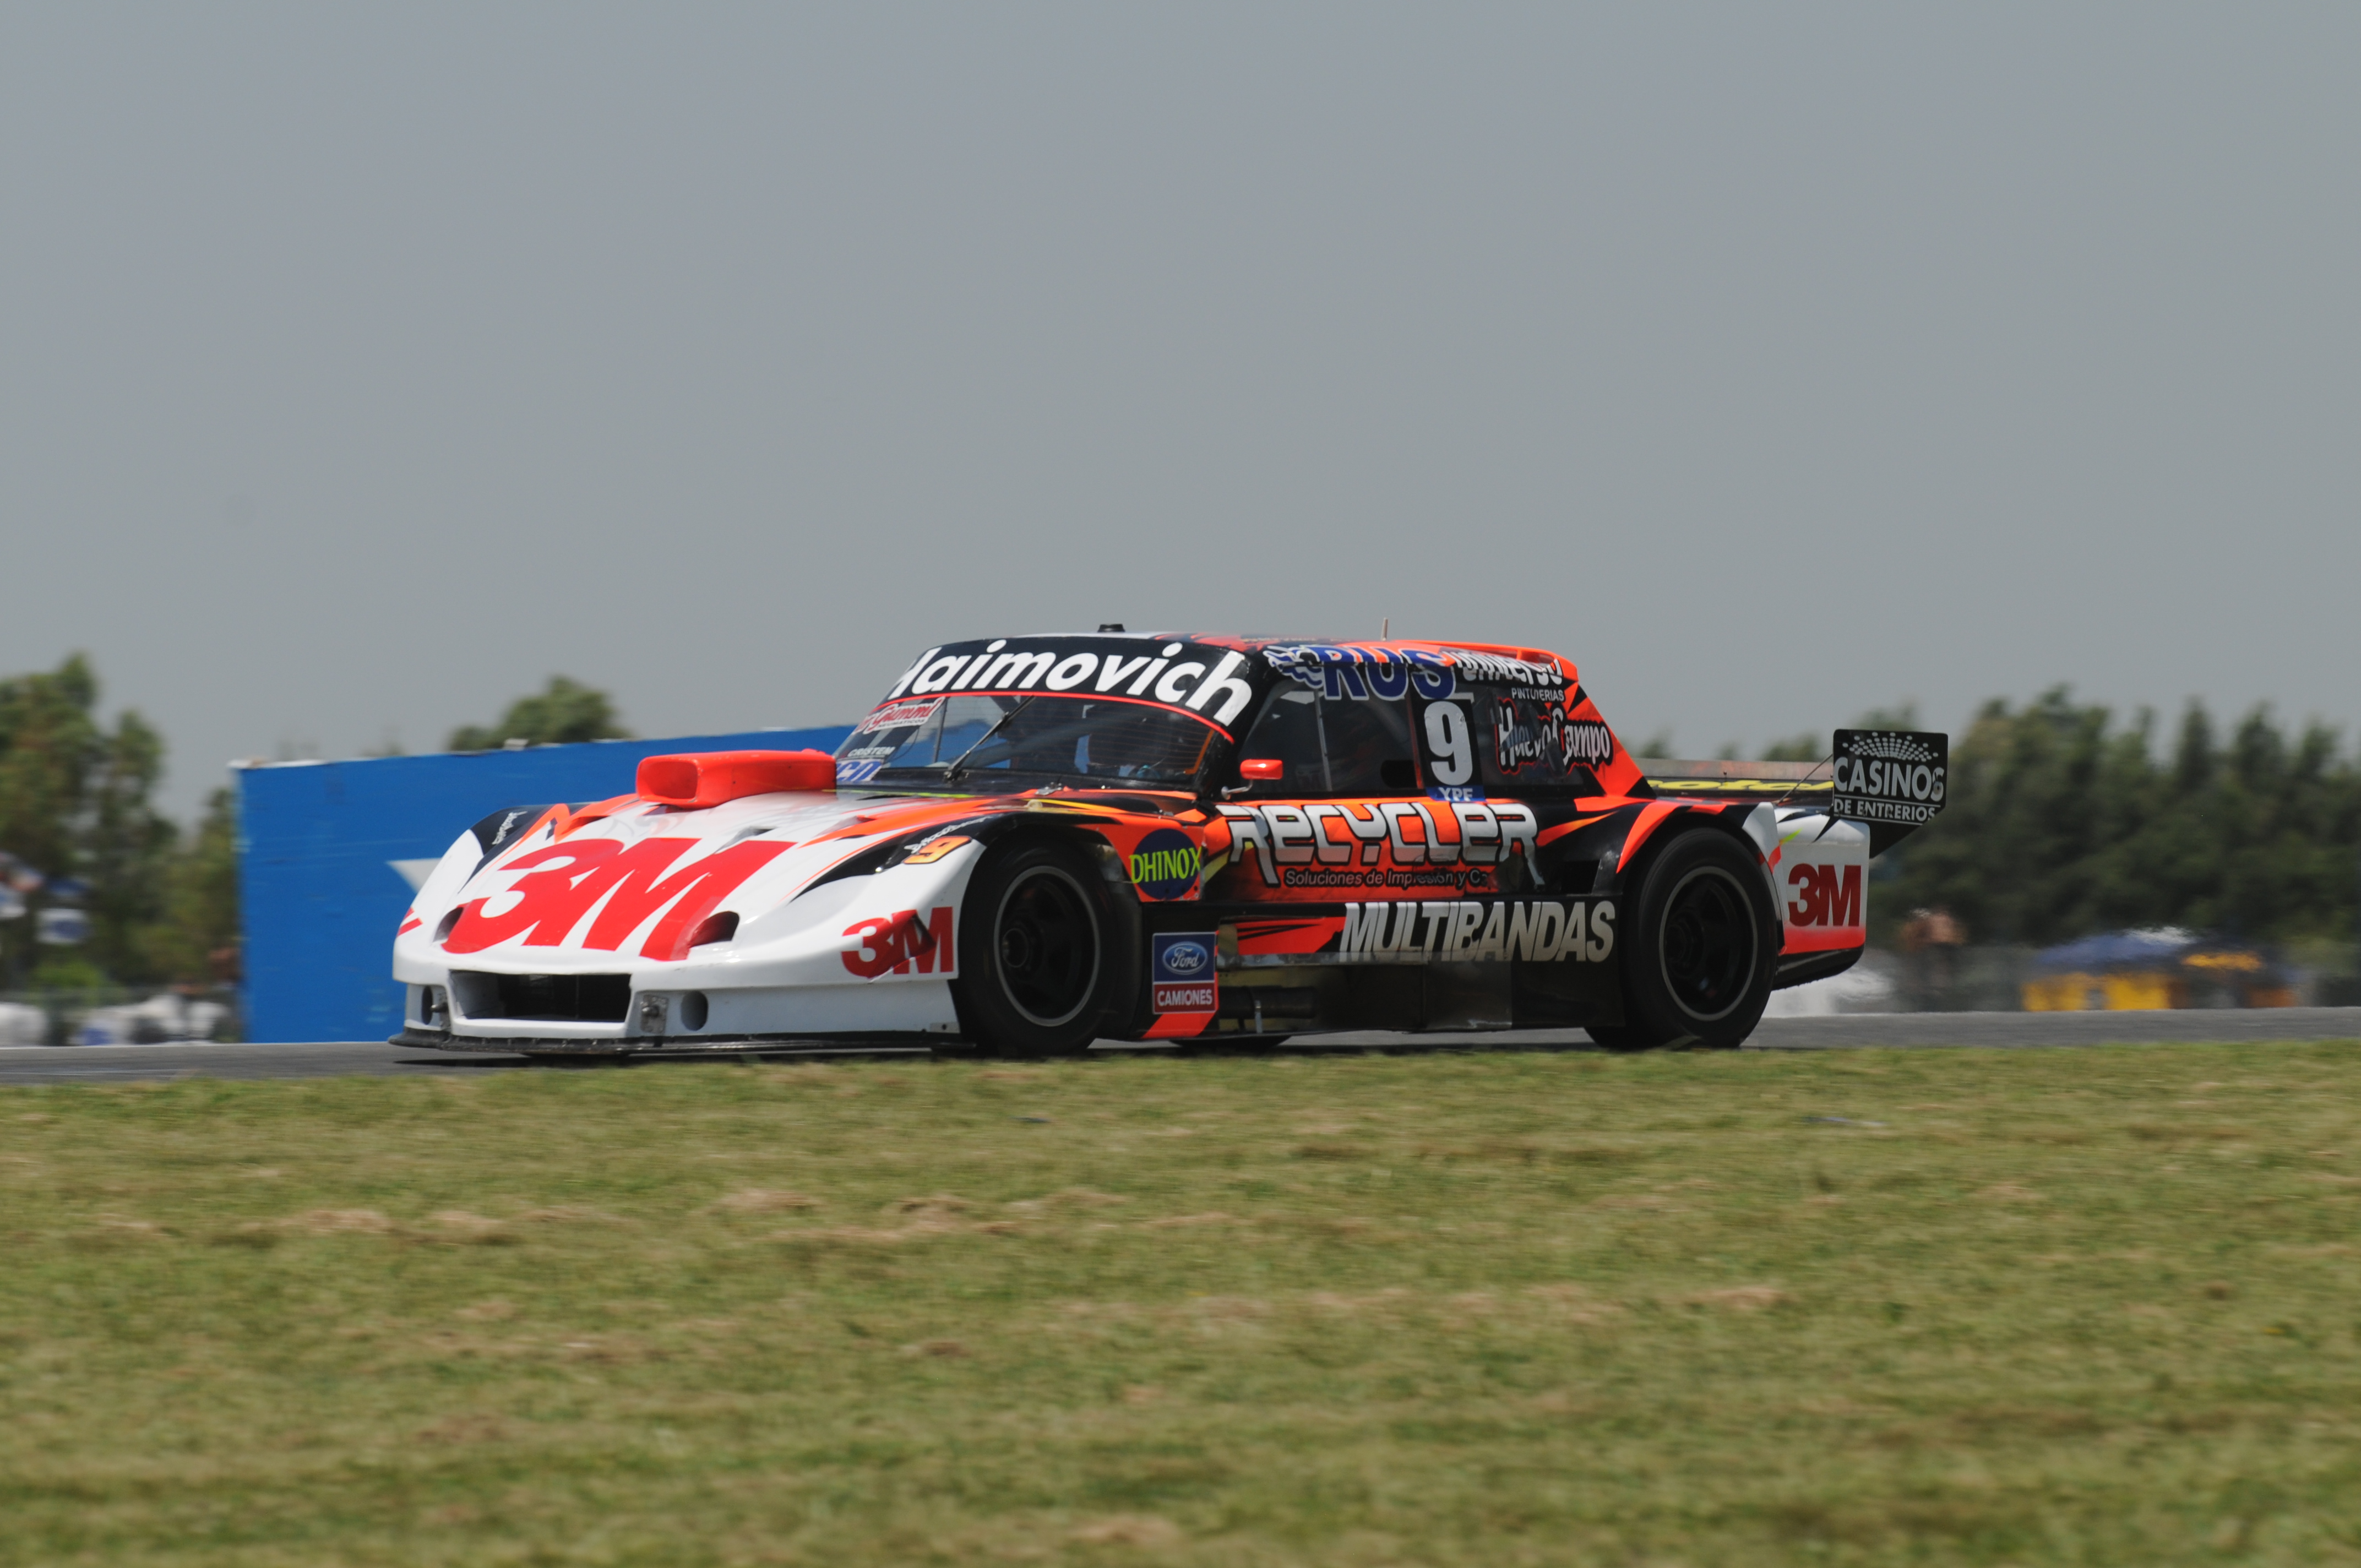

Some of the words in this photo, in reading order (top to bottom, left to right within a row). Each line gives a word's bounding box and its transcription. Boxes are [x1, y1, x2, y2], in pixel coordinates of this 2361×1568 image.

[1301, 644, 1456, 700] RUS
[1423, 701, 1473, 786] 9
[1438, 787, 1473, 802] YPF
[1834, 756, 1945, 802] CASINOS
[1834, 798, 1852, 814] DE
[902, 836, 972, 864] 9
[1129, 846, 1203, 884] DHINOX
[1286, 870, 1362, 886] Soluciones
[1366, 869, 1384, 885] de
[1458, 872, 1467, 886] y
[1787, 863, 1862, 927] 3M
[443, 837, 797, 961] 3M
[841, 906, 954, 978] 3M
[1340, 901, 1615, 963] MULTIBANDAS
[1171, 946, 1200, 970] Ford
[1157, 989, 1212, 1006] CAMIONES
